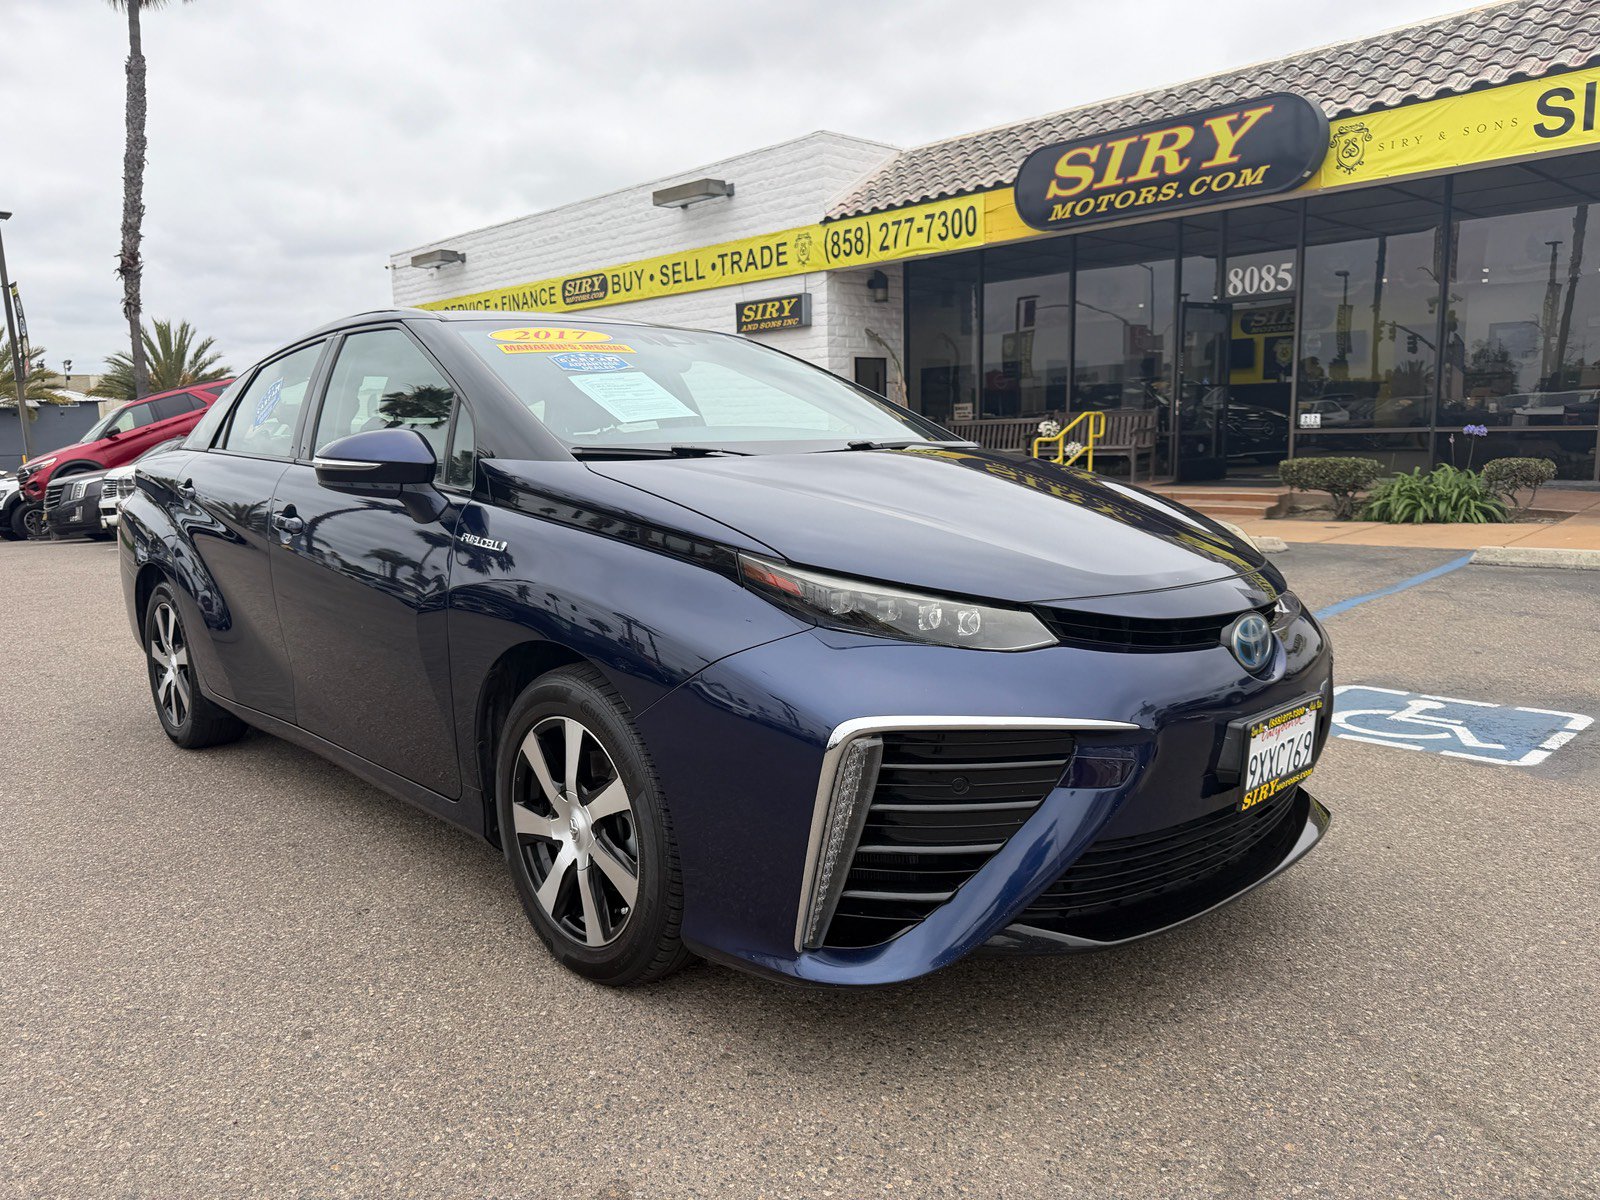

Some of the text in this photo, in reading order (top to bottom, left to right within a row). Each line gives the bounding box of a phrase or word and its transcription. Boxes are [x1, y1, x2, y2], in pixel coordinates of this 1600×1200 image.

[1377, 117, 1519, 152] SIRY & SONS
[1045, 105, 1275, 200] SIRY
[1048, 164, 1271, 222] MOTORS.COM
[824, 205, 978, 264] (858) 277-7300
[611, 241, 788, 295] BUY SELL TRADE
[1228, 263, 1293, 296] 8085
[501, 286, 557, 311] FINANCE
[565, 275, 605, 298] SIRY
[741, 298, 798, 323] SIRY
[741, 317, 800, 332] AND SONS INC
[514, 330, 588, 341] 2017
[581, 344, 632, 352] SPECIAL
[1248, 730, 1312, 792] 9XXC769
[1241, 777, 1280, 812] SIRY
